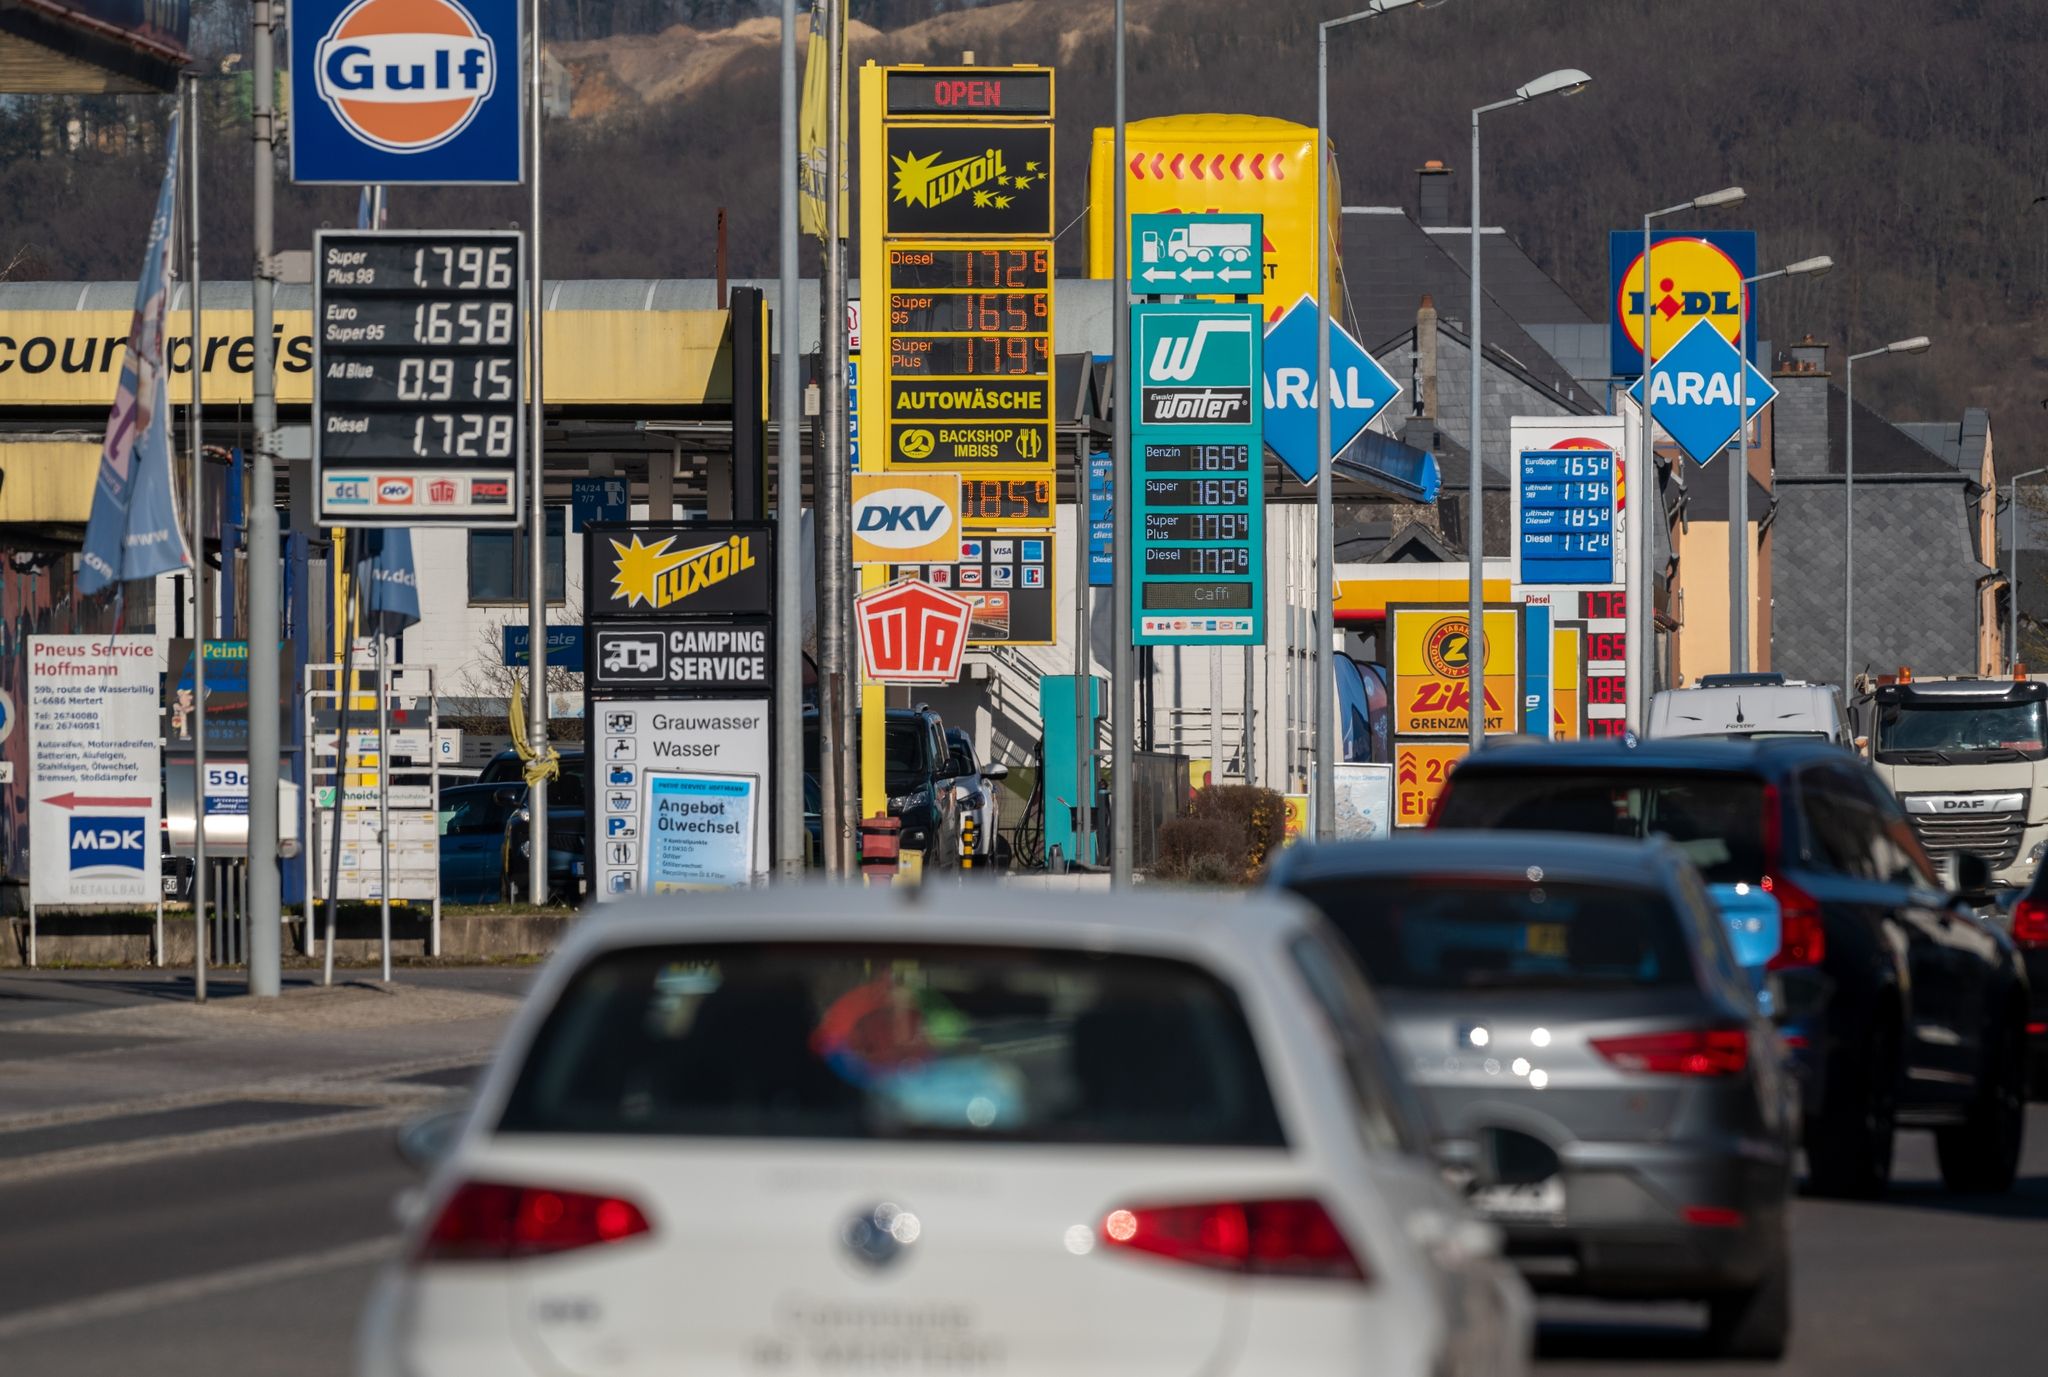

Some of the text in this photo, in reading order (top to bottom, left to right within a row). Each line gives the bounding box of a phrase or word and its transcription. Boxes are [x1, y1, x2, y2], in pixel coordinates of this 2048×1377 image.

[326, 46, 485, 90] Gulf
[934, 81, 1001, 107] OPEN
[327, 248, 367, 266] Super
[891, 252, 933, 265] Diesel
[327, 247, 512, 289] Plus 98 1.796
[891, 296, 933, 310] Super
[327, 305, 357, 320] Euro
[891, 312, 909, 324] 95
[327, 303, 513, 345] Super 95 1.658
[891, 339, 933, 353] Super
[891, 355, 921, 368] Plus
[327, 363, 344, 378] Ad
[347, 363, 374, 378] Blue
[896, 388, 1042, 410] AUTOWÄSCHE
[327, 415, 513, 457] Diesel 1.728
[939, 429, 1013, 443] BACKSHOP
[954, 444, 999, 458] IMBISS
[1146, 446, 1180, 457] Benzin
[336, 484, 360, 497] dcl
[382, 486, 408, 496] DKV
[575, 484, 601, 492] 24/24
[1146, 481, 1178, 493] Super
[581, 495, 595, 503] 7/7
[856, 505, 945, 532] DKV
[1146, 515, 1178, 527] Super
[1525, 517, 1552, 525] Diesel
[1146, 529, 1168, 539] Plus
[1525, 535, 1553, 543] Diesel
[1147, 549, 1180, 560] Diesel
[1526, 594, 1550, 604] Diesel
[865, 588, 962, 671] UTA
[670, 631, 765, 653] CAMPING
[34, 643, 153, 657] Pneus Service
[203, 643, 248, 659] Peint
[34, 661, 118, 676] Hoffmann
[670, 657, 765, 681] SERVICE
[98, 686, 155, 695] Wasserbillig
[653, 714, 760, 730] Grauwasser
[88, 741, 156, 749] Motorradreifen,
[441, 741, 451, 754] 6
[653, 741, 720, 757] Wasser
[37, 752, 80, 760] Batterien,
[80, 774, 137, 783] Stoßdämpfer
[659, 798, 725, 816] Angebot
[1943, 800, 1985, 809] DAF
[658, 813, 740, 834] Ölwechsel
[71, 830, 143, 849] MDK
[70, 885, 145, 896] METALLBAU
